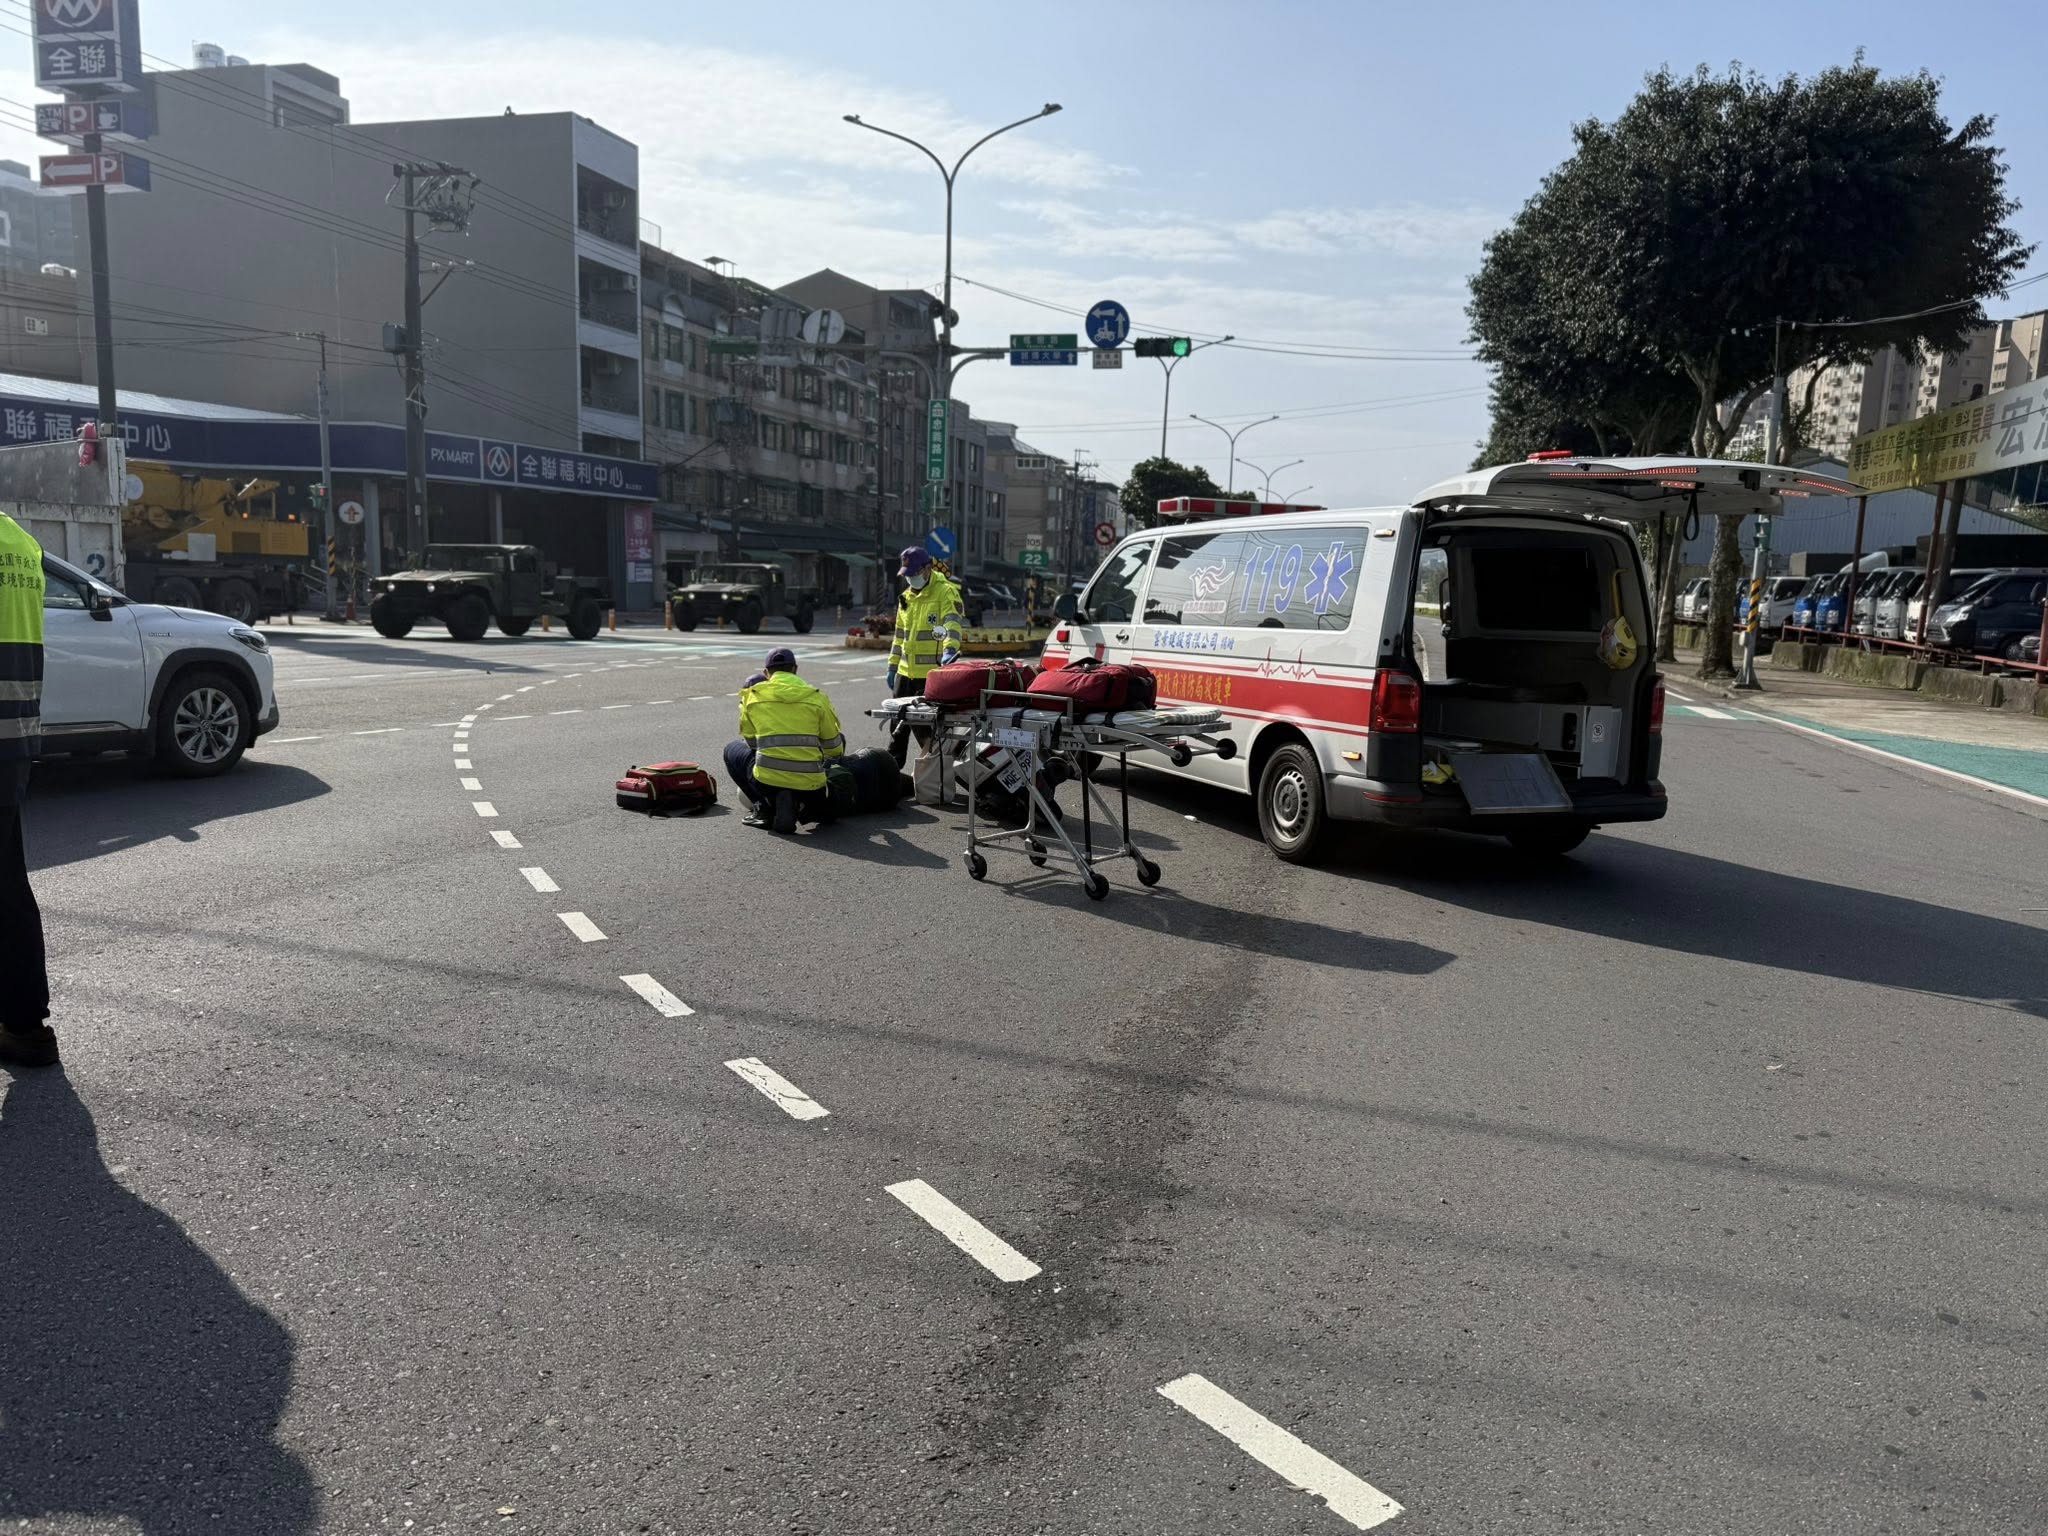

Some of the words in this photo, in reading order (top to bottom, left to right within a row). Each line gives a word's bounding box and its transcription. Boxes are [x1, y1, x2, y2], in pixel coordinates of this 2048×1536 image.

[48, 44, 107, 76] 全聯
[69, 106, 87, 131] P
[100, 156, 118, 181] P
[4, 408, 171, 452] 聯福中心
[431, 448, 445, 461] PX
[446, 450, 475, 465] MART
[521, 454, 623, 489] 全聯福利中心
[1024, 553, 1042, 565] 22
[1239, 544, 1303, 614] 119
[1152, 669, 1232, 704] 市政府消防局救護車
